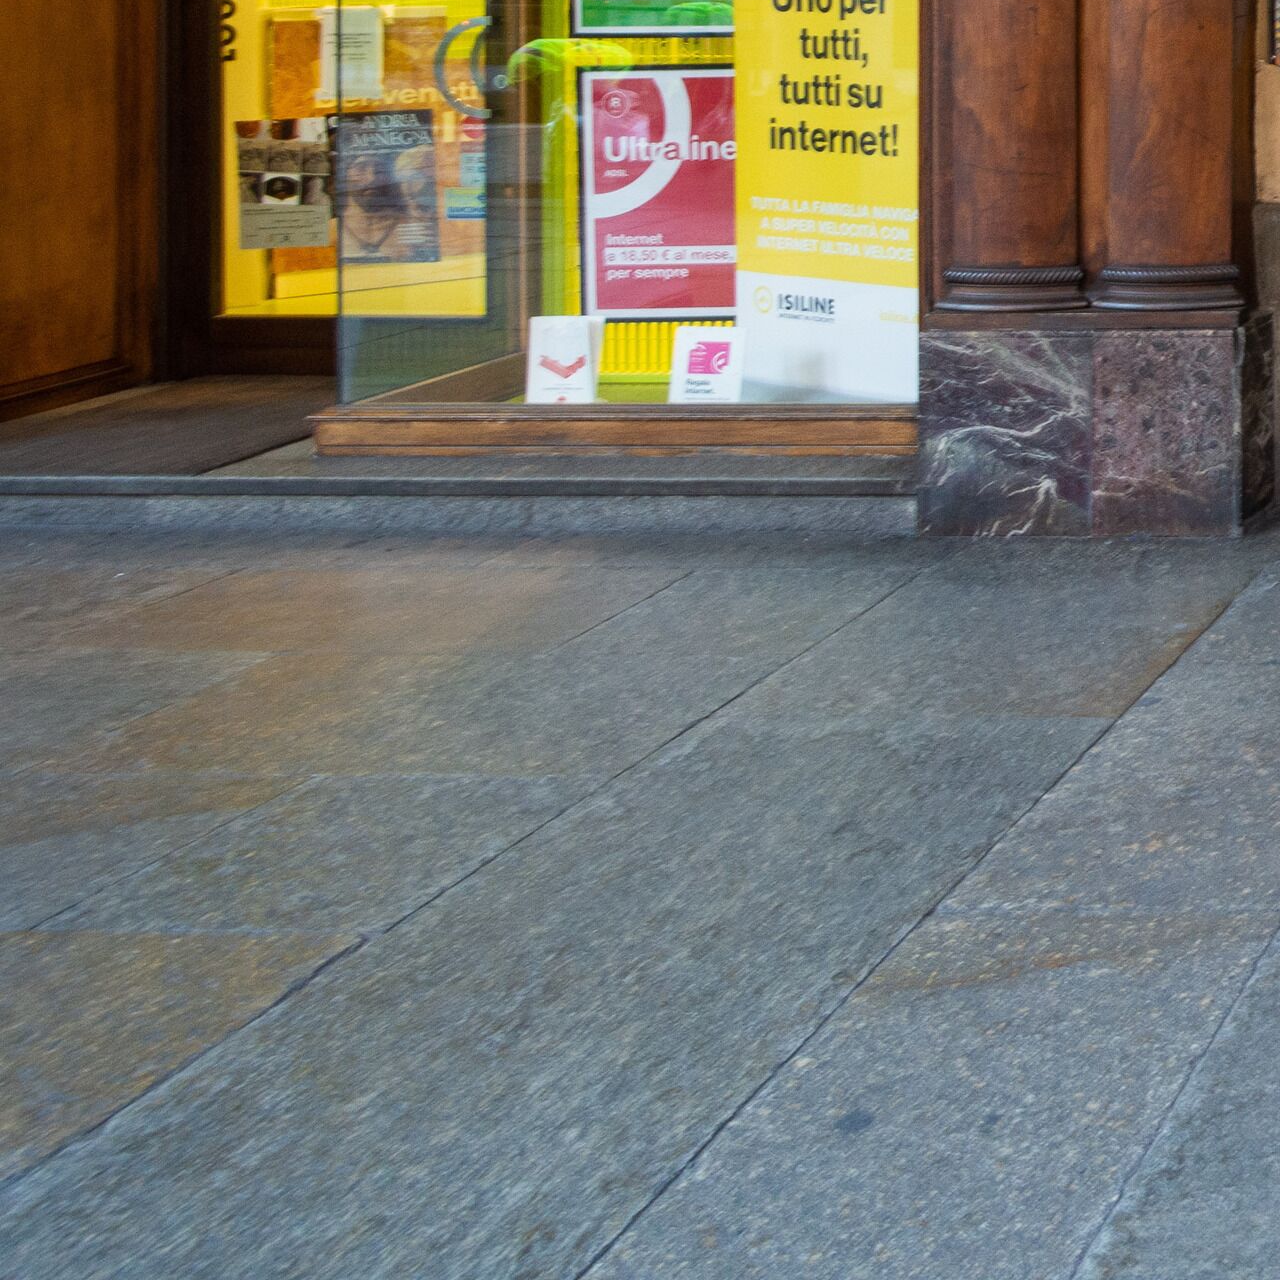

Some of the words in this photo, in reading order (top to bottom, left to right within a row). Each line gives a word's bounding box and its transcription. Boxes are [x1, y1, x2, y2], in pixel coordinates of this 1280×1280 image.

[799, 28, 869, 69] tutti,
[779, 74, 841, 107] tutti
[847, 82, 883, 109] su
[603, 135, 738, 163] Ultraline
[769, 118, 899, 157] internet!
[751, 196, 789, 211] TUTTA
[792, 199, 810, 213] LA
[605, 233, 664, 246] Internet
[771, 217, 816, 233] SUPER
[879, 226, 910, 241] CON
[756, 235, 818, 252] INTERNET
[820, 240, 861, 257] ULTRA
[863, 244, 914, 262] VELOCE
[605, 269, 632, 281] per
[633, 268, 690, 281] sempre
[777, 293, 836, 315] ISILINE
